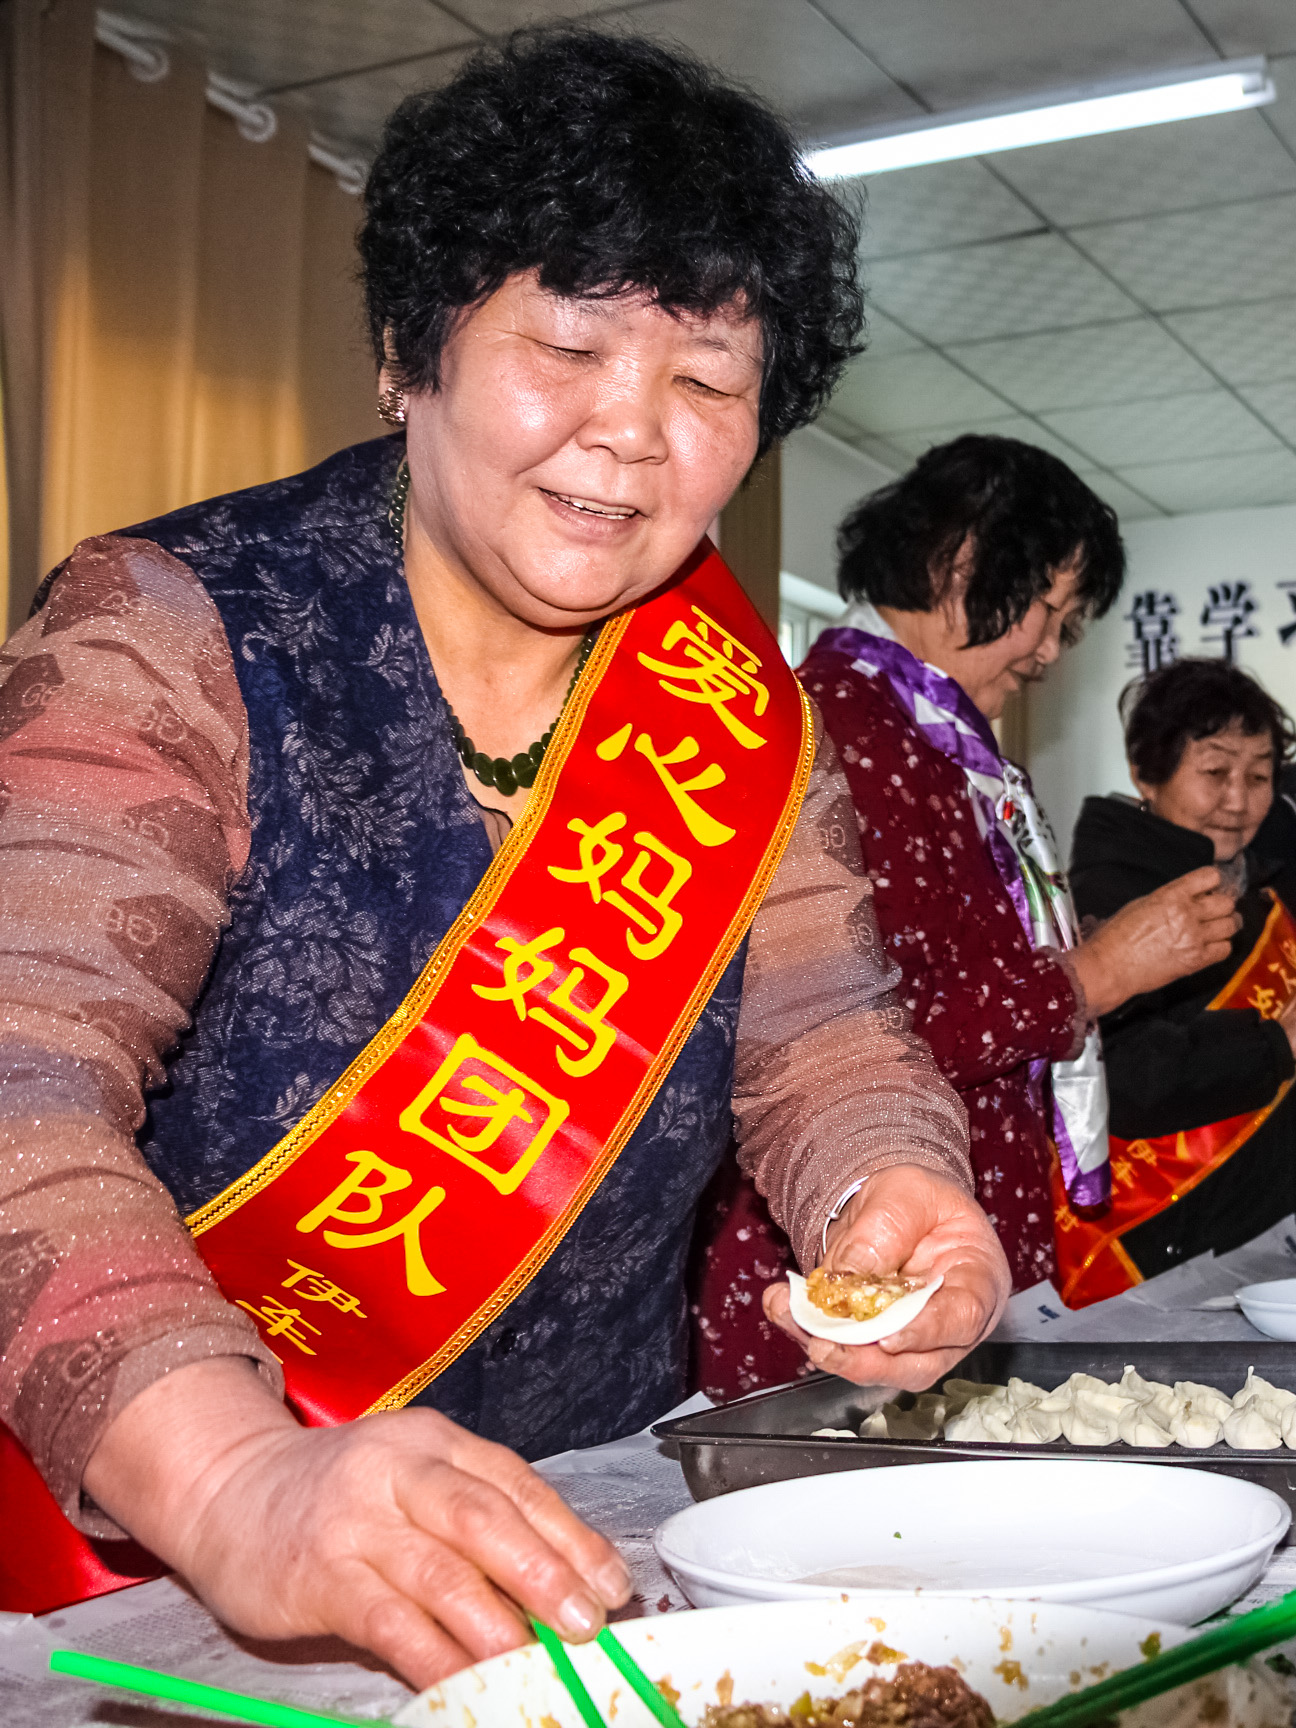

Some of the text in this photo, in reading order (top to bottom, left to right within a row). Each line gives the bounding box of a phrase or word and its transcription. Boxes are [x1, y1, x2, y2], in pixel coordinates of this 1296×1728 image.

[235, 605, 770, 1364] 爱心妈妈团队 伊车
